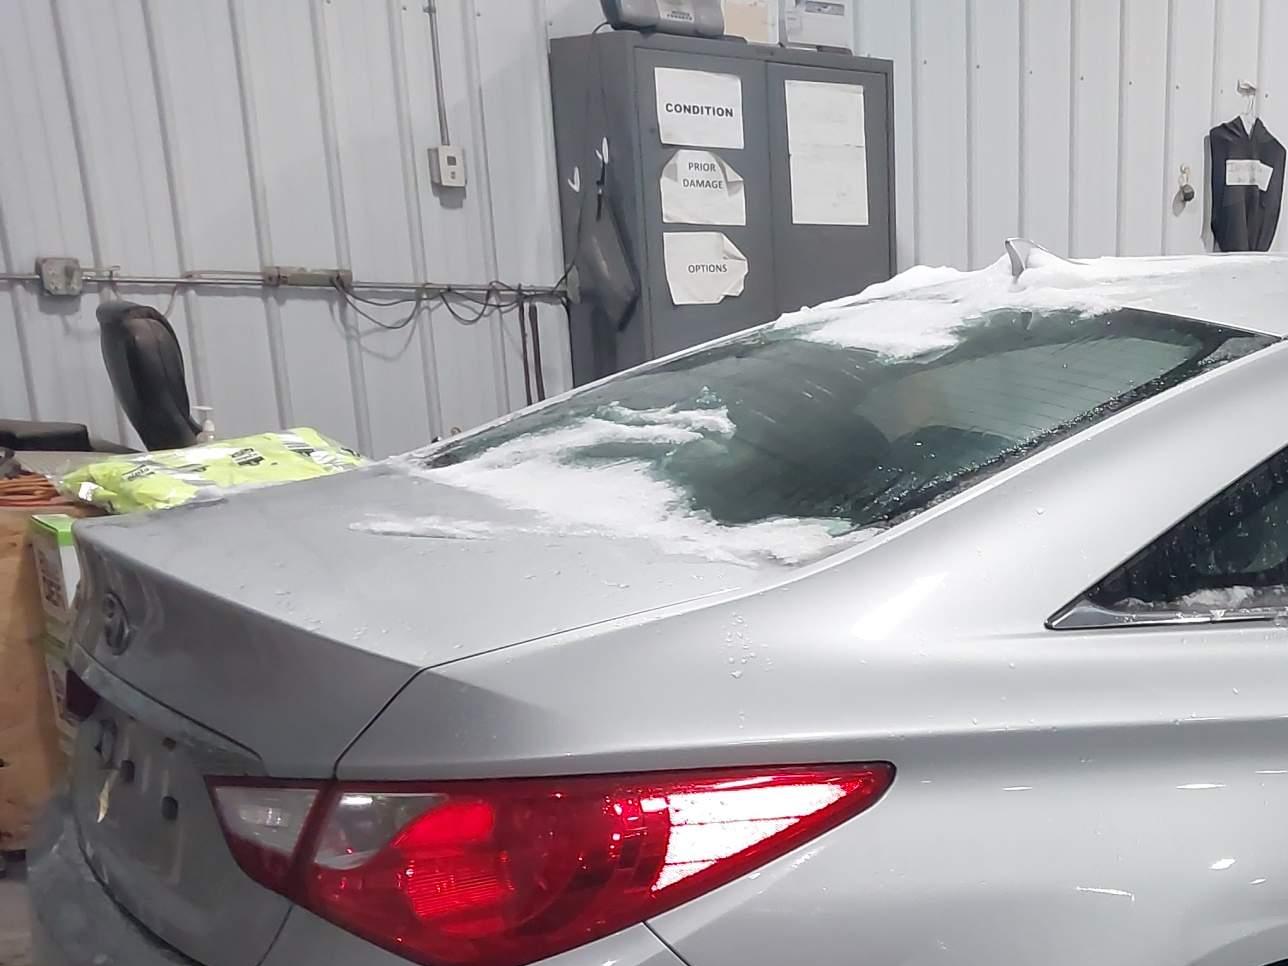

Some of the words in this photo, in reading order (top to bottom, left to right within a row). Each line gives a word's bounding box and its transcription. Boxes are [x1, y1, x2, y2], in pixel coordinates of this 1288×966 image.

[665, 102, 734, 118] CONDITION
[688, 161, 717, 173] PRIOR
[682, 178, 723, 190] DAMAGE
[687, 263, 728, 274] OPTIONS
